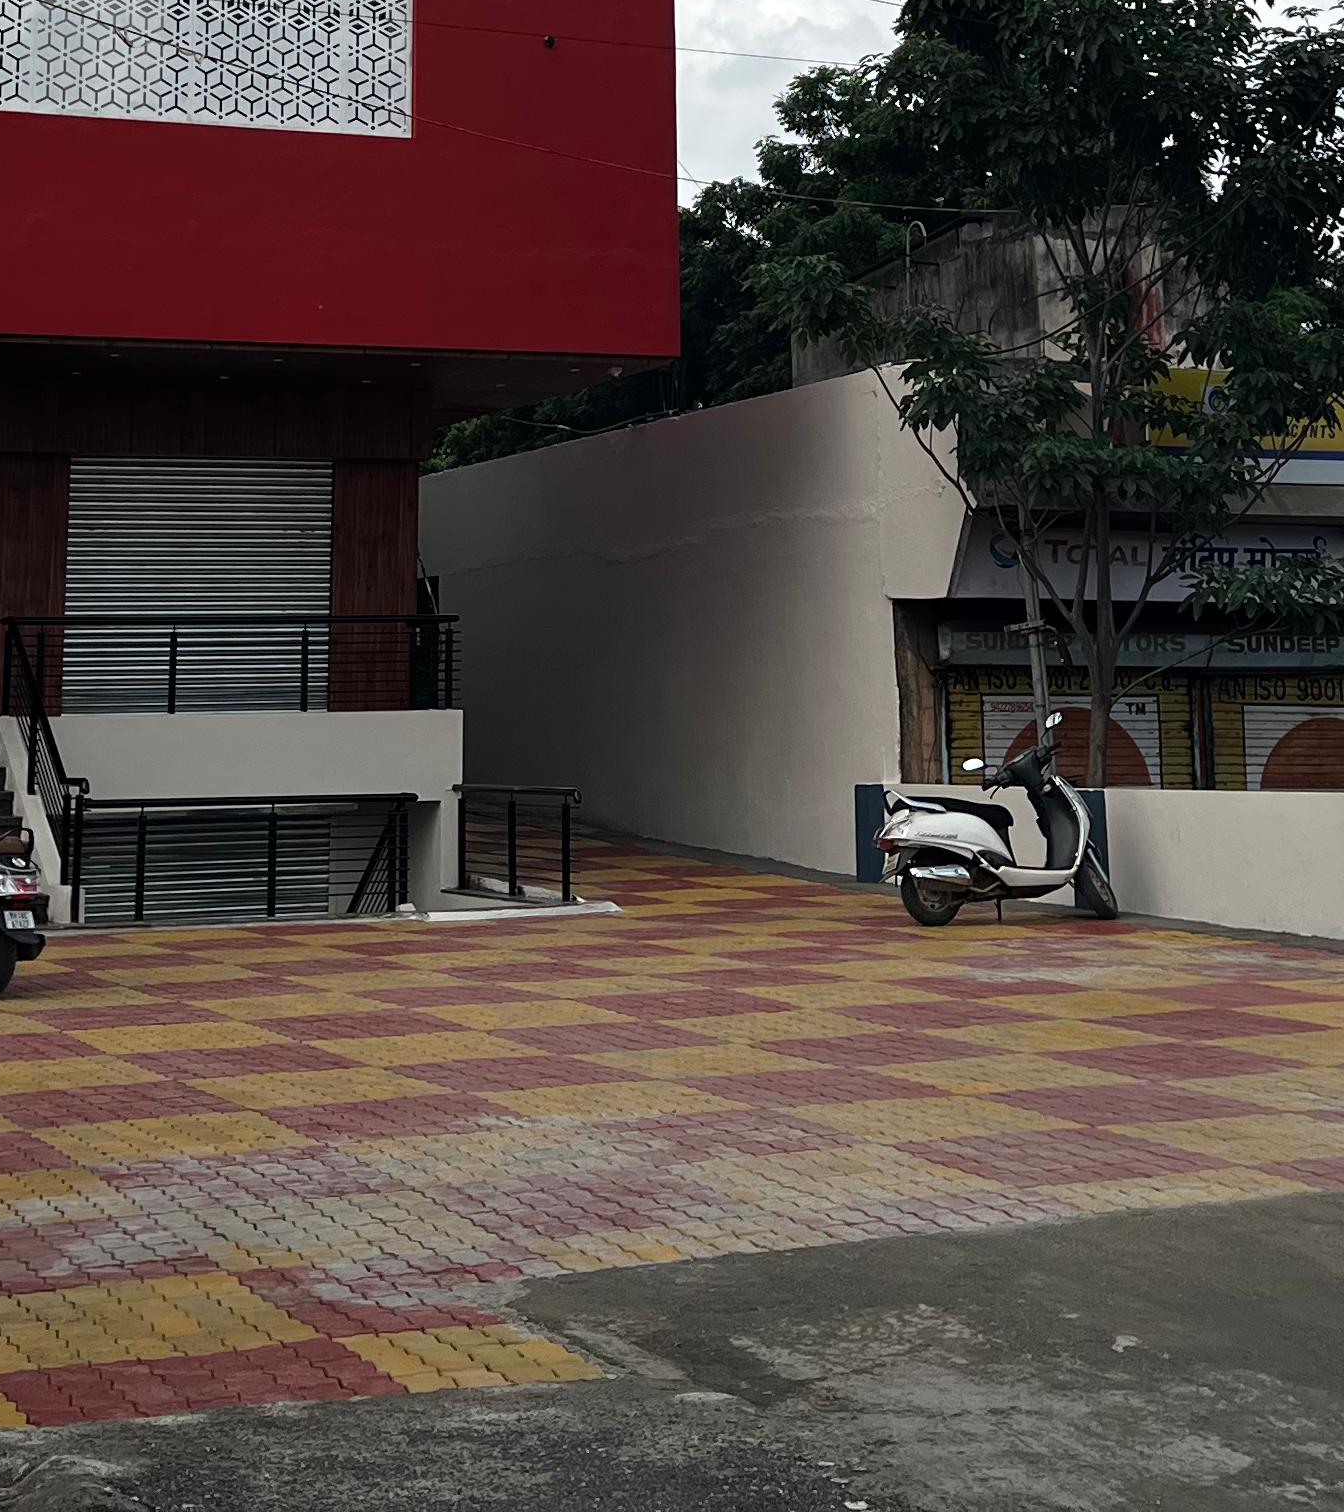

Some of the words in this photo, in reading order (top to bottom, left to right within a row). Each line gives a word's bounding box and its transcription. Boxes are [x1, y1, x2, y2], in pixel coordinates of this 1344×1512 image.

[1227, 635, 1340, 654] SUNDEEP
[987, 668, 1017, 690] ISO
[1217, 678, 1246, 700] AN
[1255, 677, 1286, 701] ISO
[1127, 702, 1146, 715] TM
